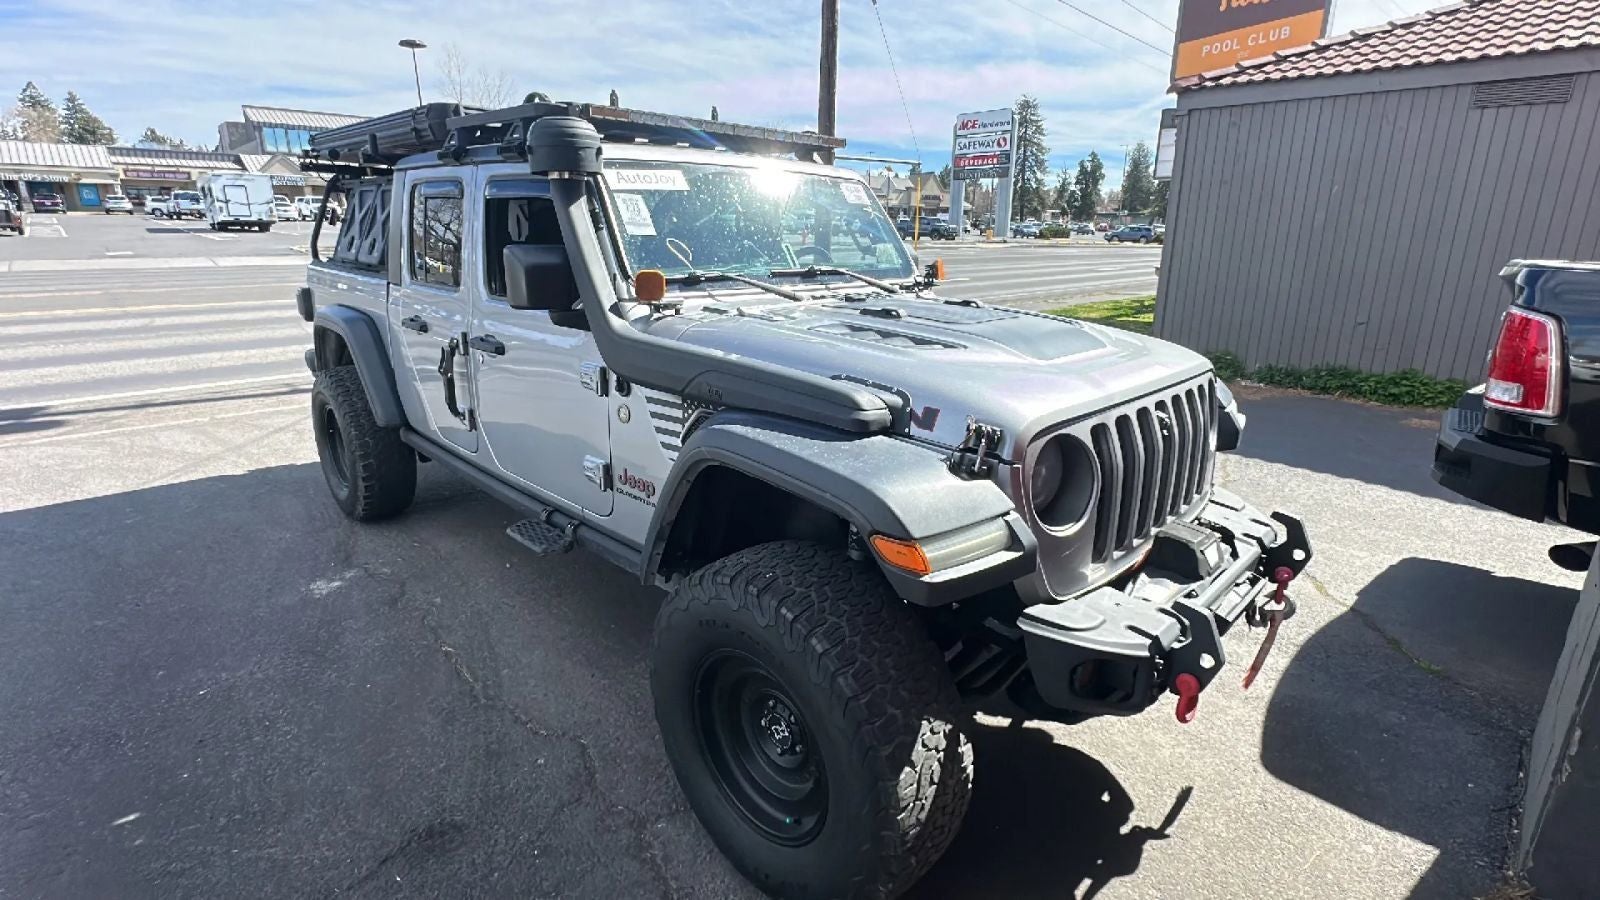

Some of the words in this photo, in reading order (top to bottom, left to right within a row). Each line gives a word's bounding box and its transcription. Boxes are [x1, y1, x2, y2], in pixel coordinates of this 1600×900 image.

[1202, 39, 1240, 57] POOL
[1247, 27, 1290, 46] CLUB
[958, 119, 978, 130] ACE
[978, 120, 1010, 129] Hardware
[957, 139, 996, 151] SAFEWAY
[21, 173, 41, 181] UPS
[42, 174, 69, 183] Store
[616, 171, 676, 186] AutoJoy
[617, 468, 656, 499] Jeep
